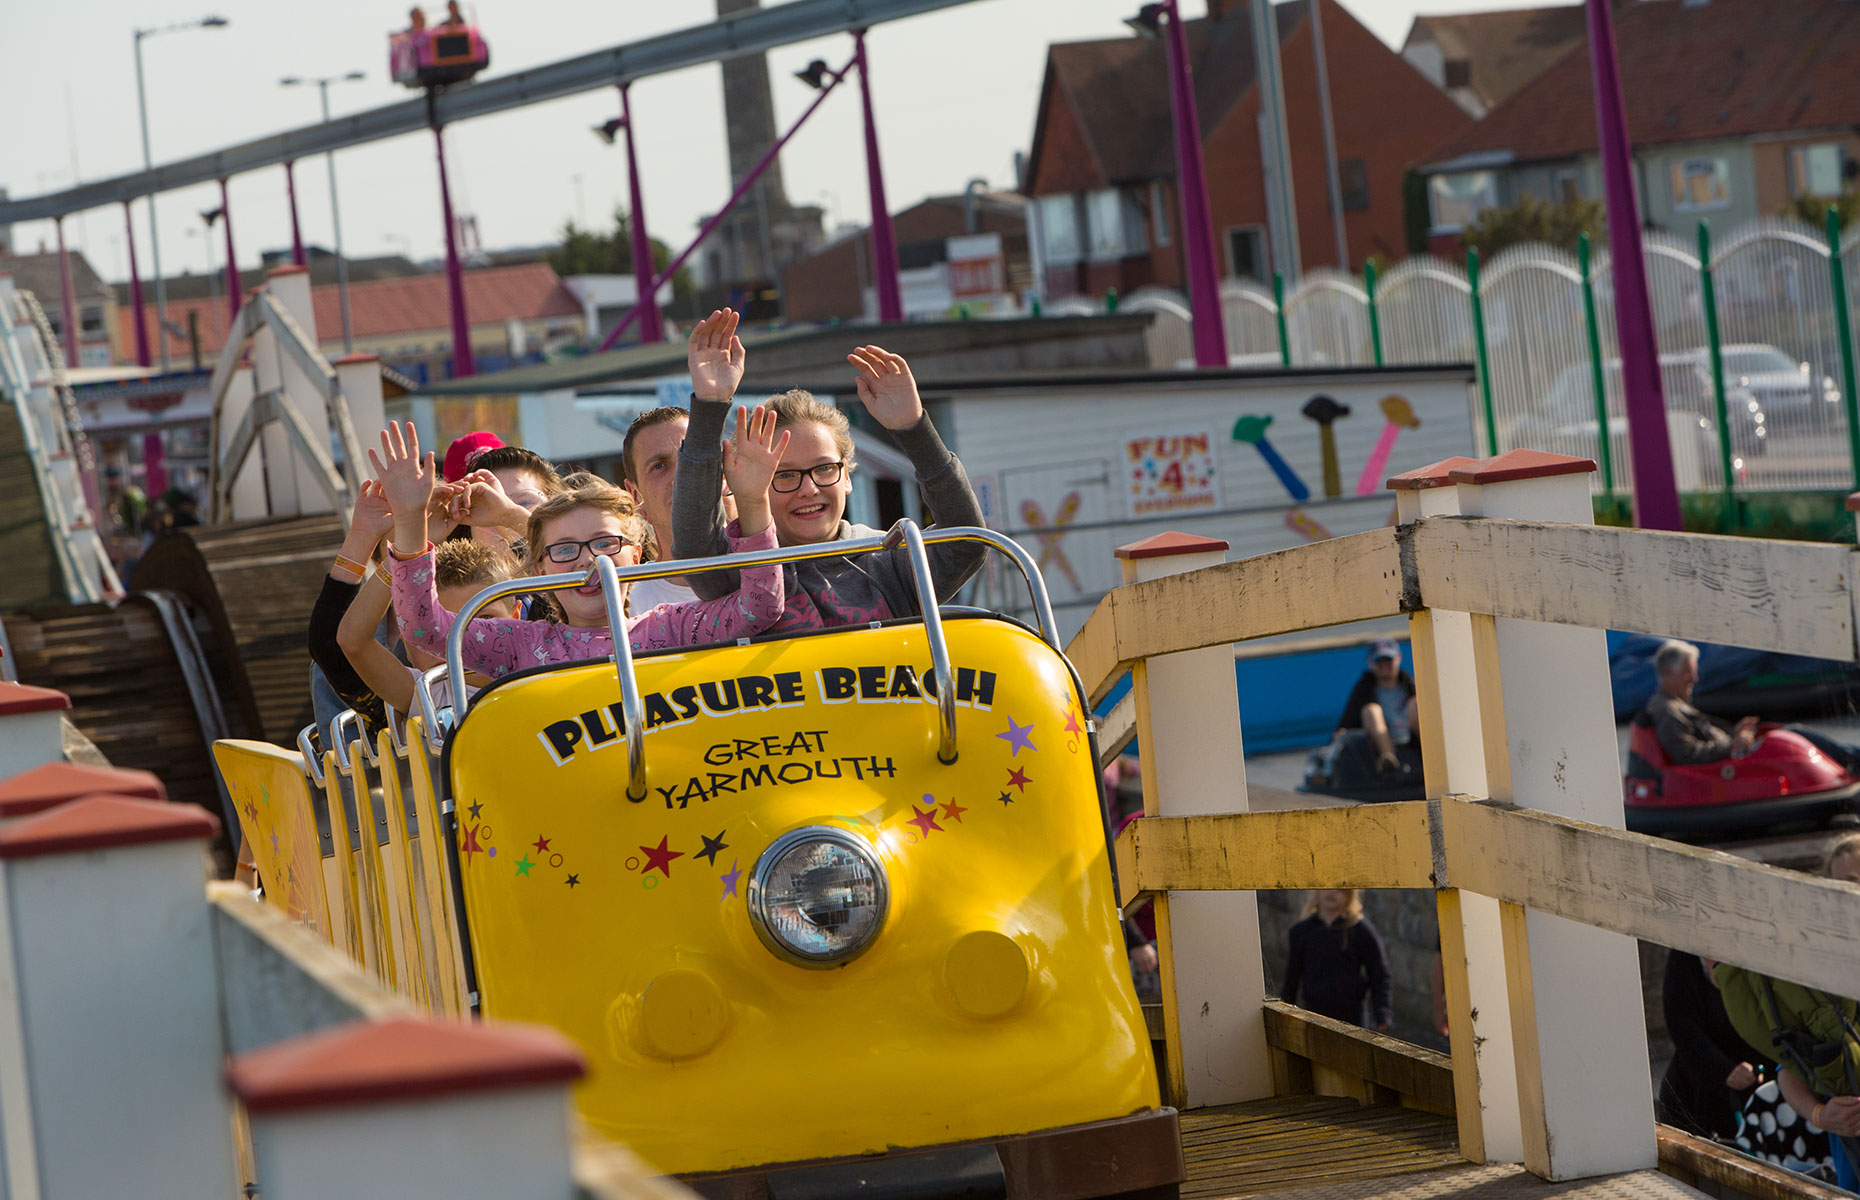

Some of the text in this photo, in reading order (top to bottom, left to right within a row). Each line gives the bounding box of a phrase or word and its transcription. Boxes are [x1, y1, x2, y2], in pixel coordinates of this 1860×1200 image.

[1126, 433, 1209, 462] FUN
[1158, 461, 1184, 495] 4
[703, 730, 829, 767] GREAT
[655, 755, 898, 810] YARMOUTH
